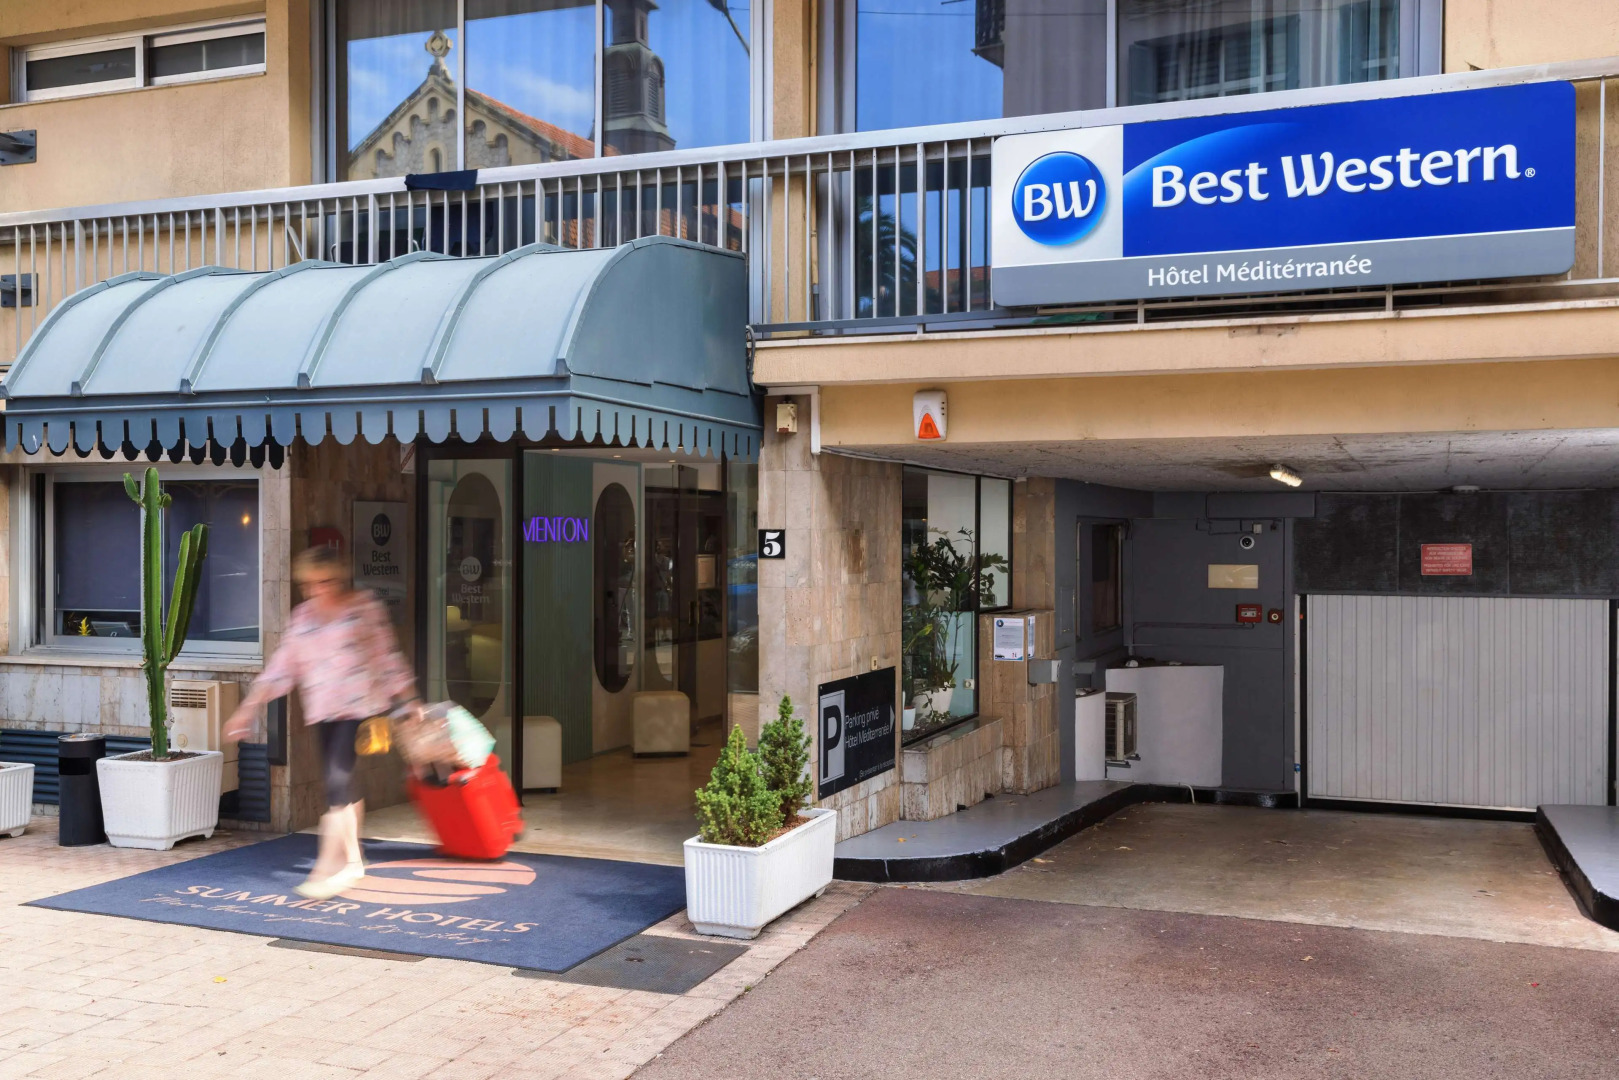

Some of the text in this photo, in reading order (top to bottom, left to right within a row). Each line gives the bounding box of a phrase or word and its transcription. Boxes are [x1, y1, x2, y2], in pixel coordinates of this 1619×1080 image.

[1152, 162, 1269, 208] Best
[1023, 179, 1097, 222] BW
[1148, 254, 1372, 287] Hôtel Méditérranée
[373, 523, 390, 538] BW
[522, 516, 589, 543] MENTON
[763, 531, 782, 556] 5
[371, 550, 391, 563] Best
[363, 564, 399, 576] Western
[451, 593, 490, 604] Western
[460, 583, 482, 594] Best
[845, 706, 880, 729] Parking privé
[823, 704, 842, 779] P
[845, 730, 859, 749] Hôtel
[174, 885, 540, 933] SUMMER HOTELS
